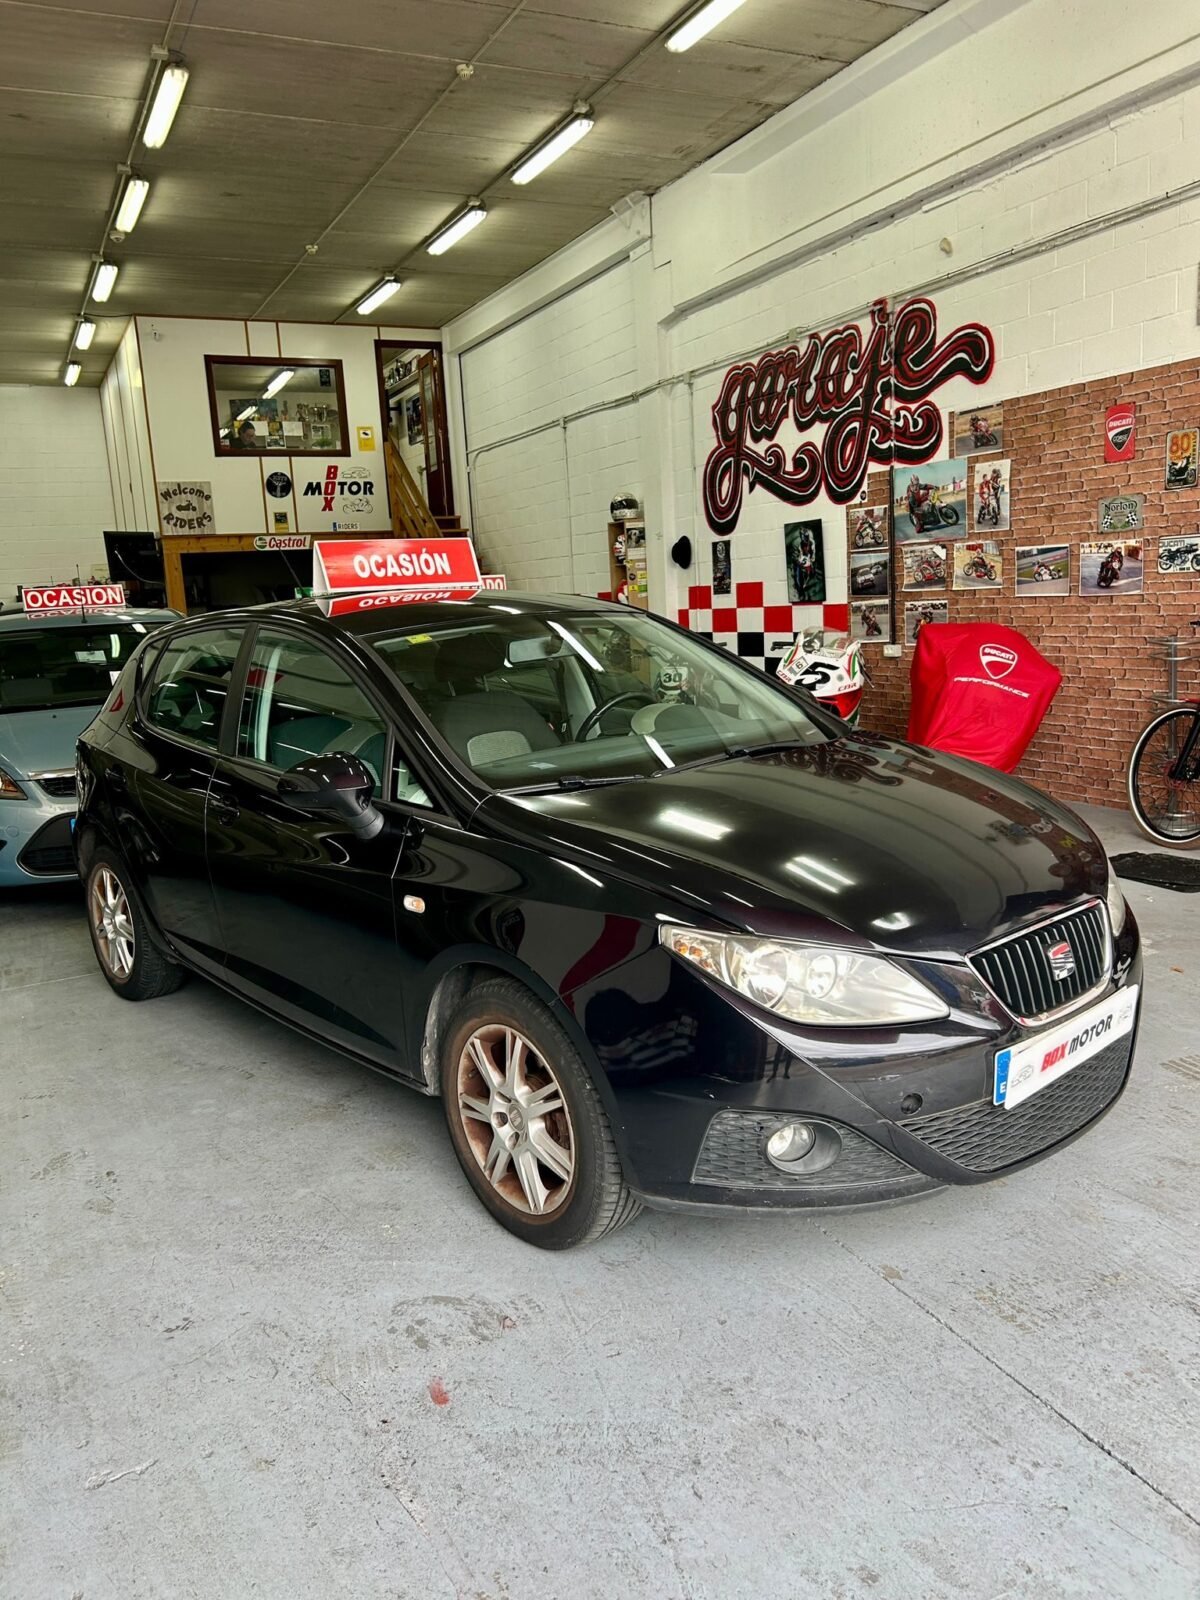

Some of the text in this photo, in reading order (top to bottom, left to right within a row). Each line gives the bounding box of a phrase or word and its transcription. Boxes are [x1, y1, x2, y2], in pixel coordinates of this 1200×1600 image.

[703, 297, 995, 537] garaje
[1108, 418, 1132, 428] DUCATI
[160, 483, 212, 502] Welcome
[303, 480, 374, 496] MOTOR
[321, 465, 338, 512] BOX
[1102, 501, 1137, 512] Norton
[163, 511, 212, 530] RIDERS
[268, 537, 306, 549] Castrol
[1159, 540, 1185, 548] DUCATI
[353, 547, 452, 578] OCASIÓN
[26, 588, 122, 607] OCASION
[984, 647, 1014, 660] DUCATI
[663, 672, 682, 683] 30
[954, 677, 1030, 698] PERFORMANCE
[1041, 1014, 1113, 1072] BOX MOTOR
[1000, 1081, 1007, 1093] E
